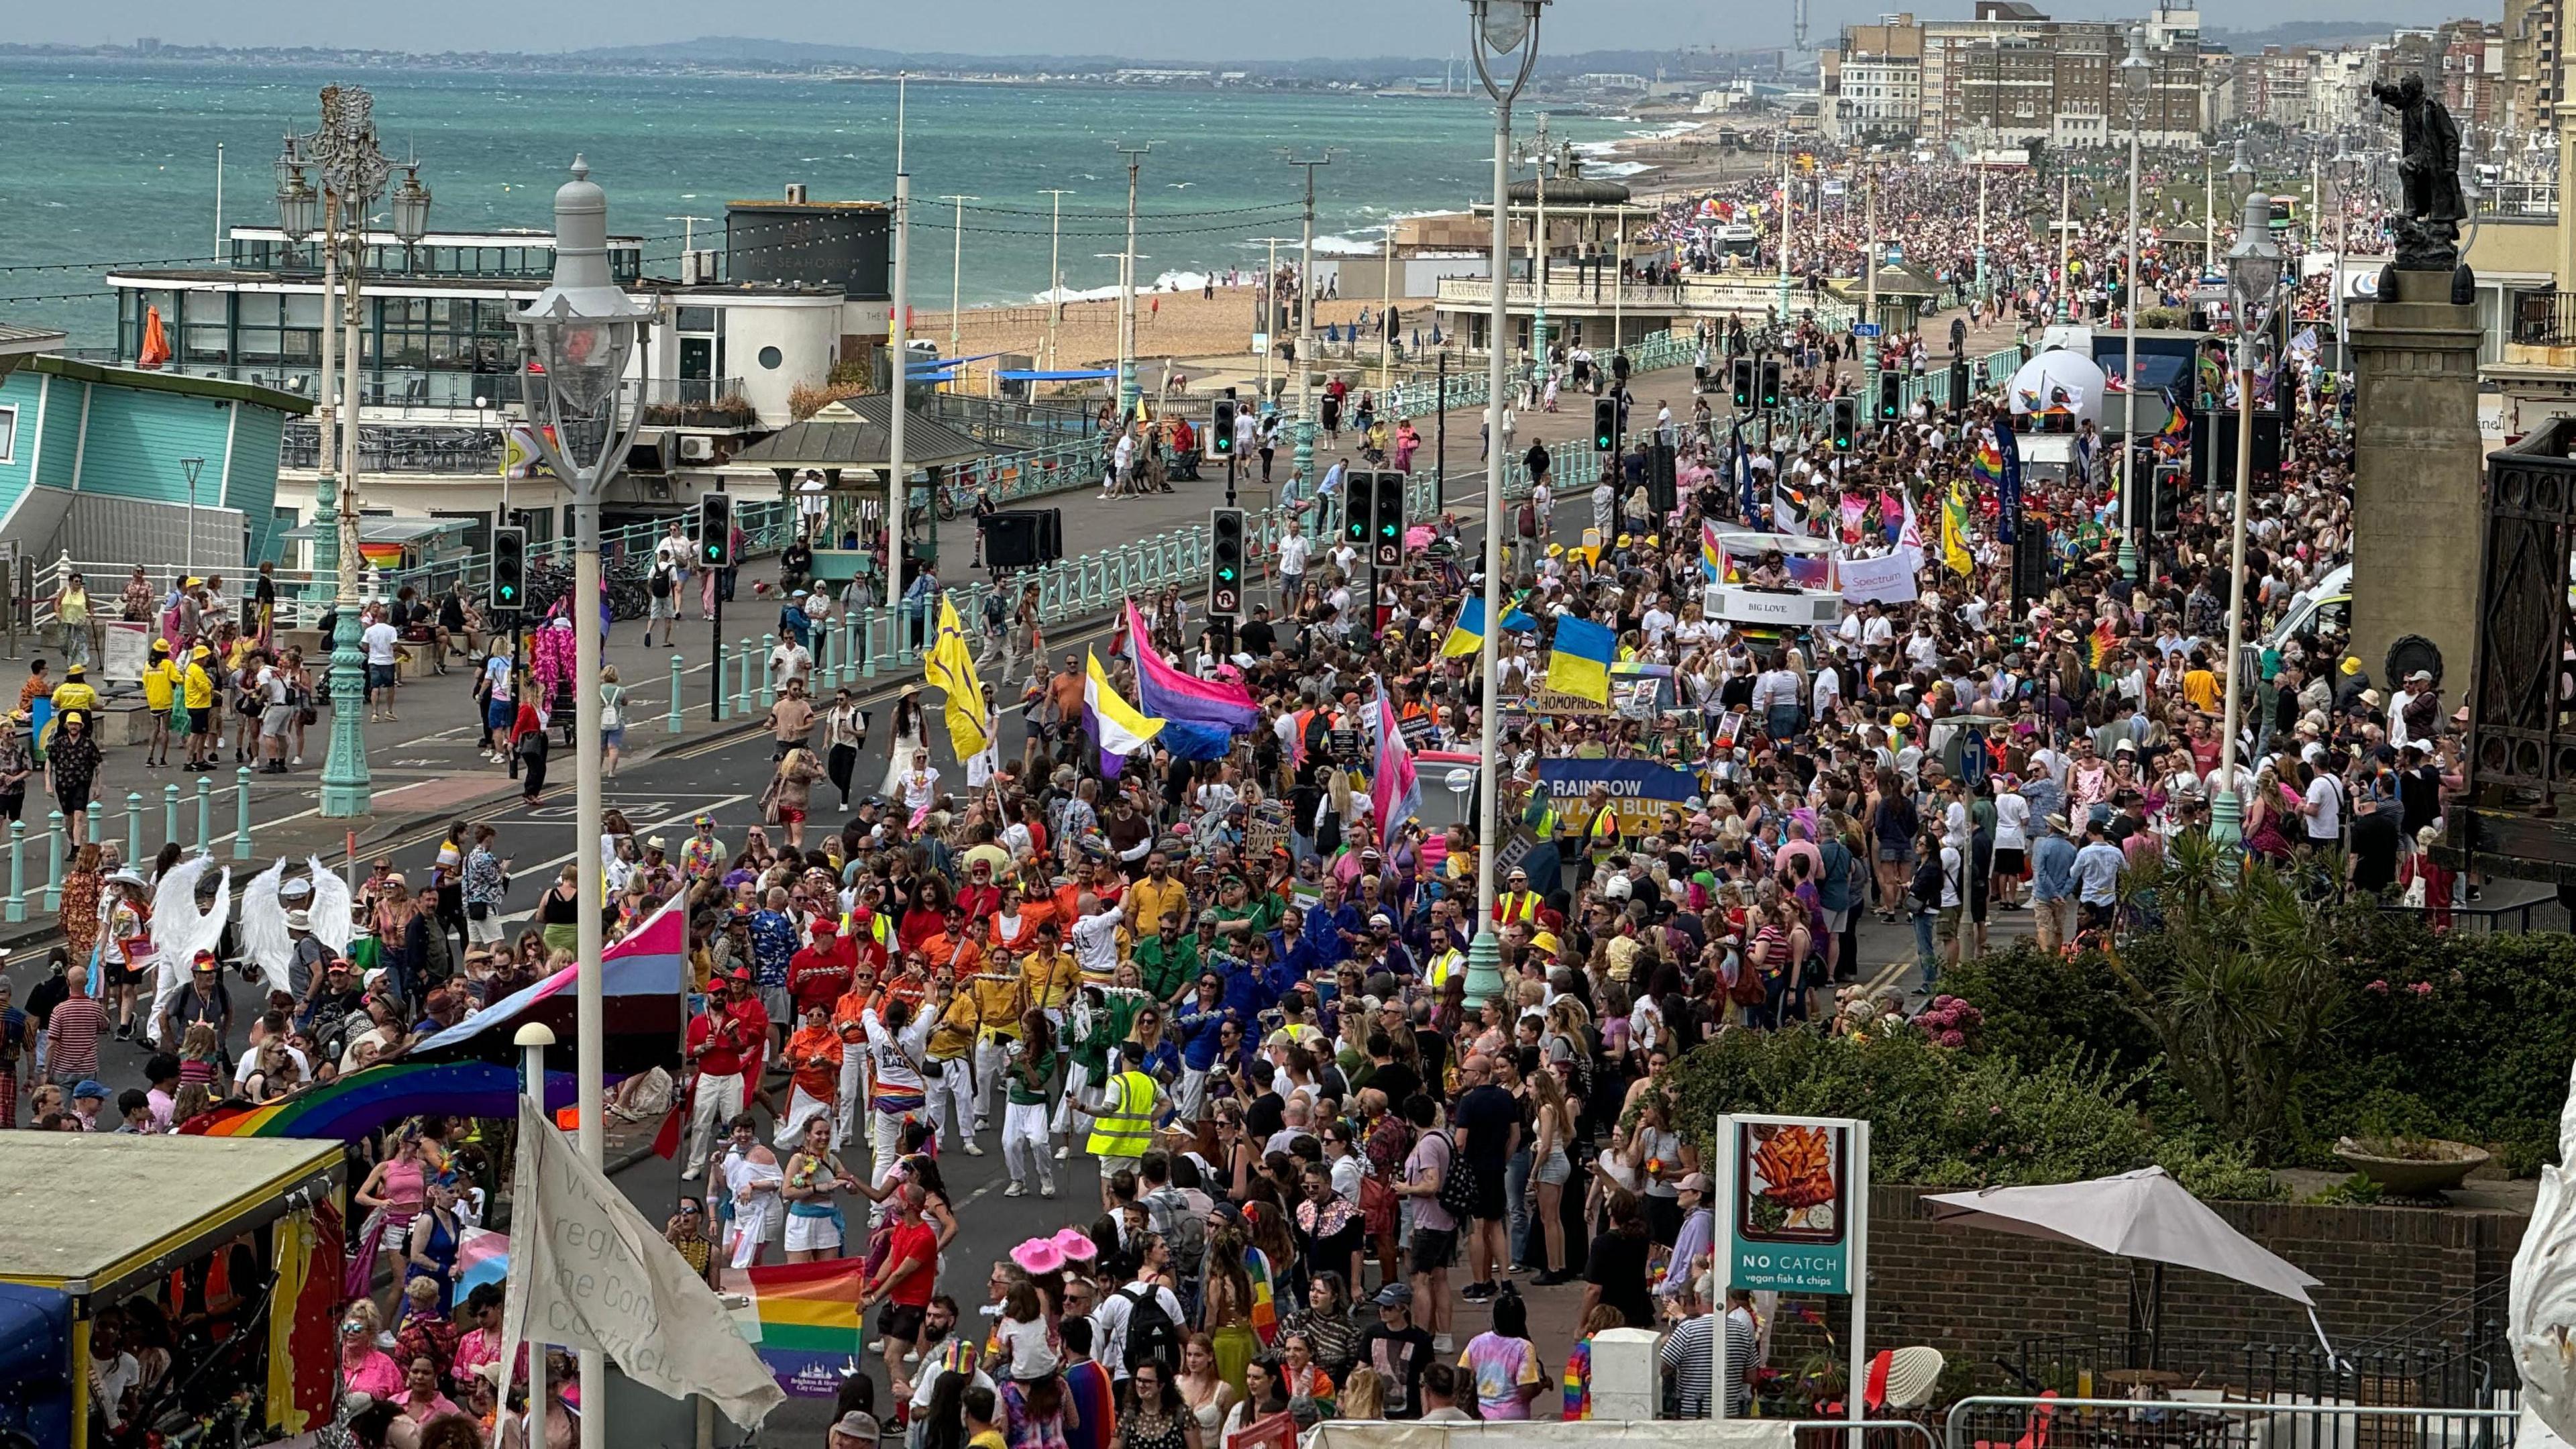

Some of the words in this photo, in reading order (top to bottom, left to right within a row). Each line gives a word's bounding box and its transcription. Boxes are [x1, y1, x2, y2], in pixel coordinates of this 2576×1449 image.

[747, 258, 767, 267] THE
[777, 257, 852, 268] SEAHORSE
[866, 311, 881, 321] THE
[1851, 572, 1901, 590] Spectrum
[1748, 603, 1763, 612] BIG
[1764, 604, 1788, 613] LOVE
[1540, 694, 1611, 710] HOMOPHOB
[1552, 780, 1642, 796] RAINBOW
[1623, 800, 1670, 817] BLUE
[1248, 824, 1289, 835] STAND
[1742, 1255, 1771, 1268] NO
[1779, 1256, 1837, 1272] CATCH
[1744, 1275, 1774, 1285] vegan
[1776, 1273, 1794, 1284] fish
[1796, 1275, 1804, 1284] &
[1806, 1275, 1832, 1287] chips
